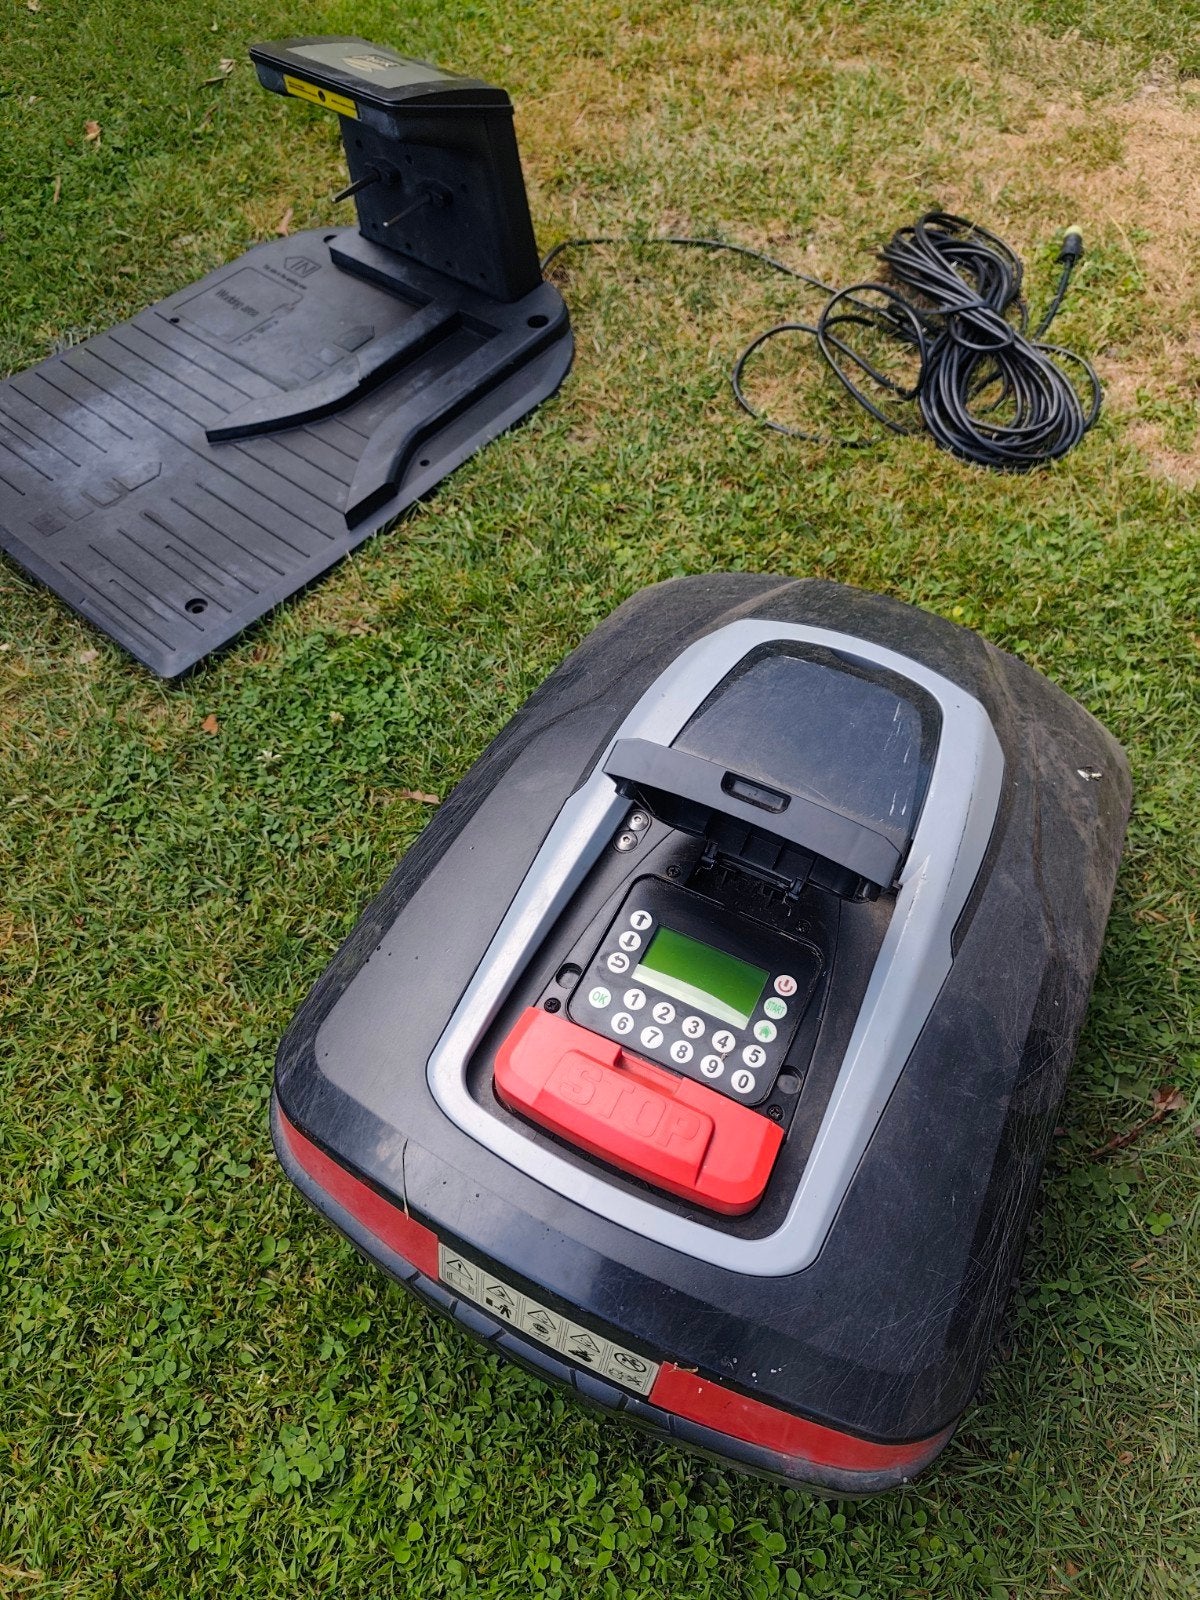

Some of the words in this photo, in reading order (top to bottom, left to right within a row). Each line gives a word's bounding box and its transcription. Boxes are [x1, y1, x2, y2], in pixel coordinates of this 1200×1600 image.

[290, 260, 317, 274] IN
[592, 991, 606, 1005] OK
[766, 1000, 786, 1014] START
[631, 993, 640, 1007] 1
[658, 1006, 671, 1021] 2
[687, 1020, 700, 1035] 3
[717, 1035, 730, 1049] 4
[748, 1049, 762, 1064] 5
[616, 1016, 629, 1031] 6
[647, 1030, 660, 1043] 7
[676, 1044, 689, 1059] 8
[706, 1059, 719, 1074] 9
[737, 1073, 750, 1089] 0
[559, 1067, 702, 1148] STOP
